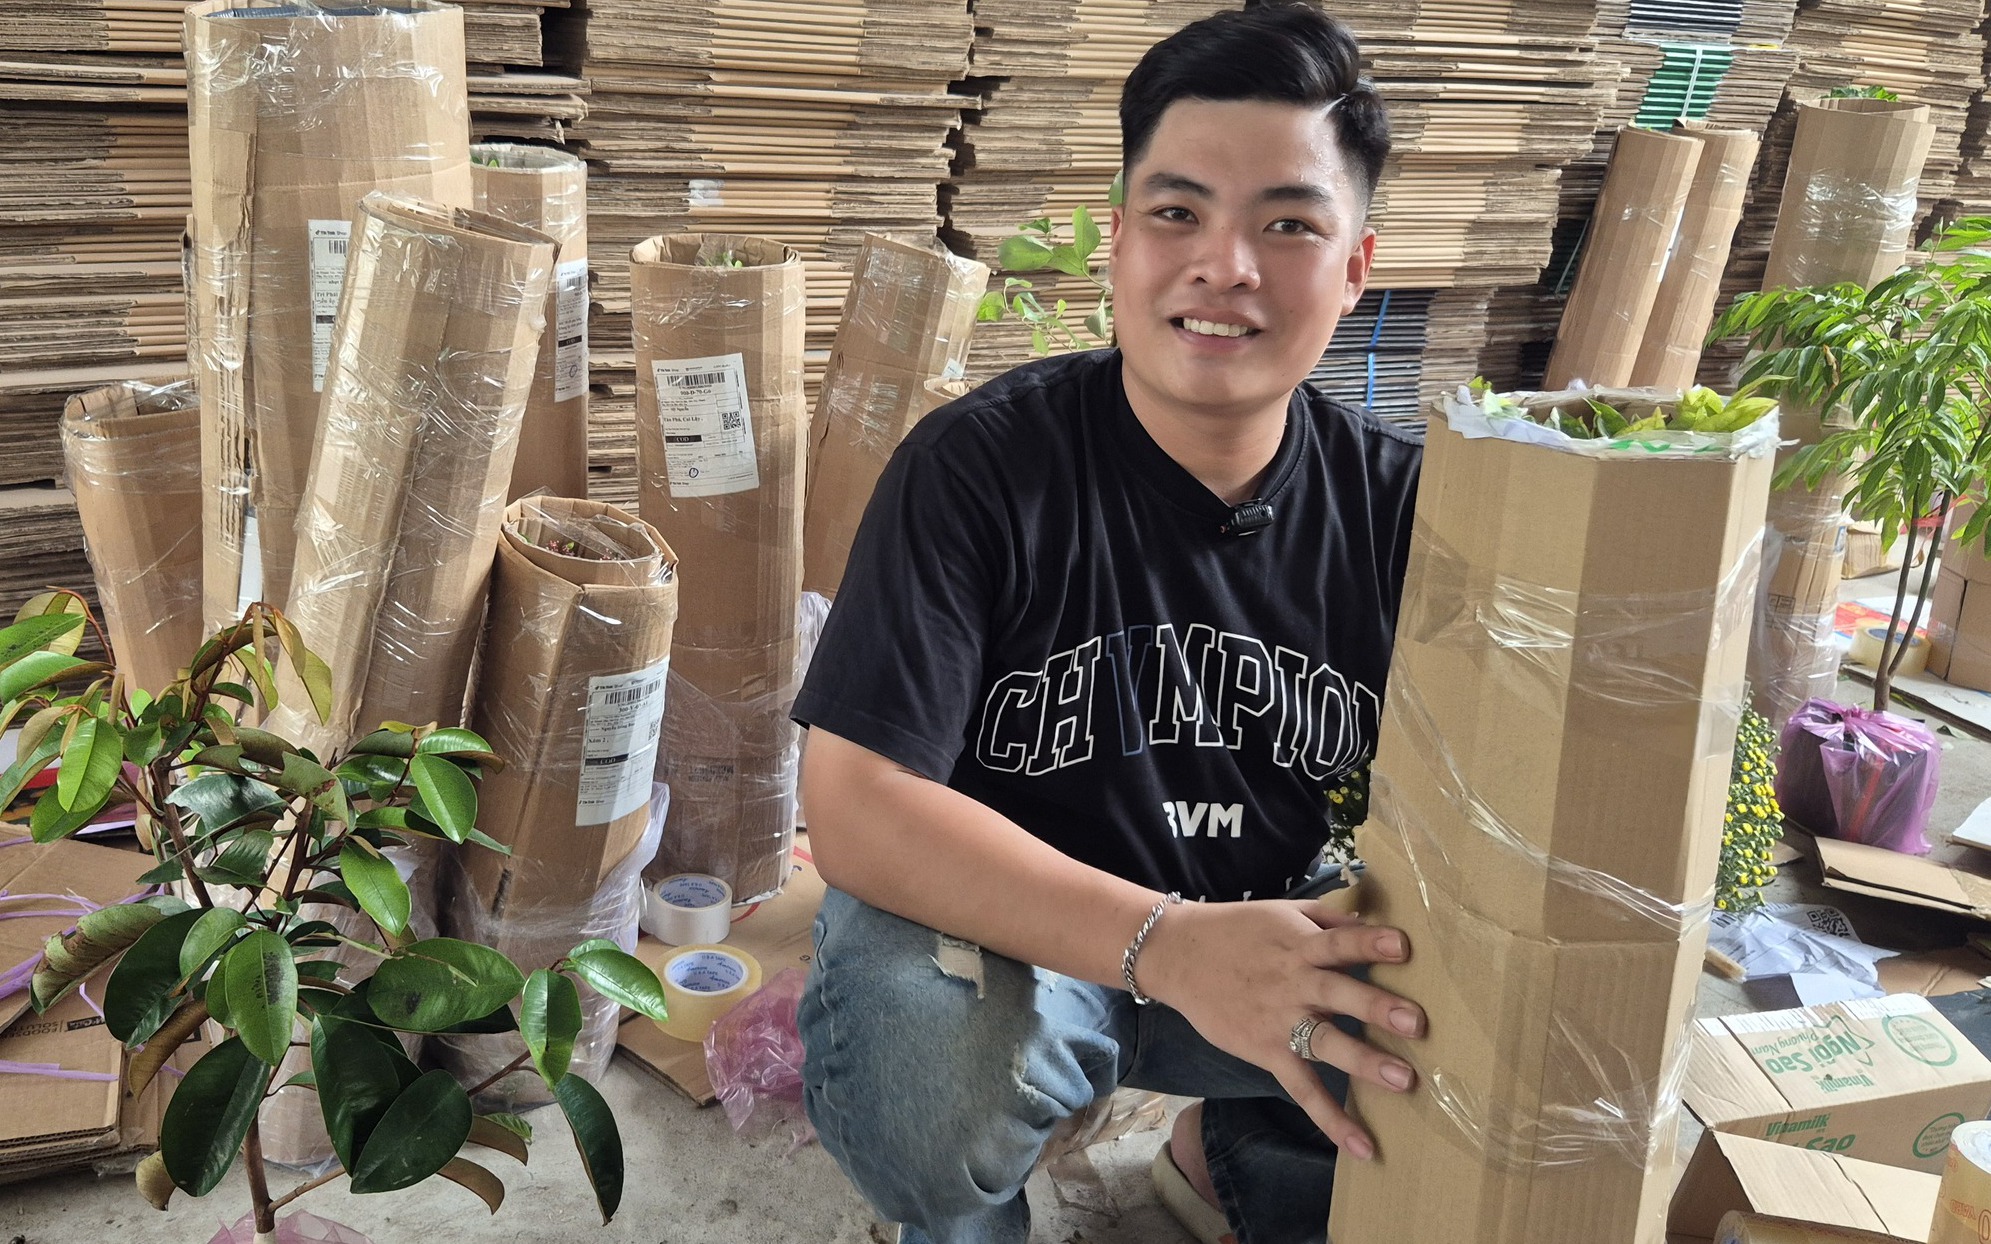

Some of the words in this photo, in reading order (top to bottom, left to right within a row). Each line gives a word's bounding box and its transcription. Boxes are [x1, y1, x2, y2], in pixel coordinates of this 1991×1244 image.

[1765, 1052, 1814, 1074] Sao
[1815, 1074, 1874, 1094] Vinamilk
[1766, 1112, 1832, 1137] Vinamilk
